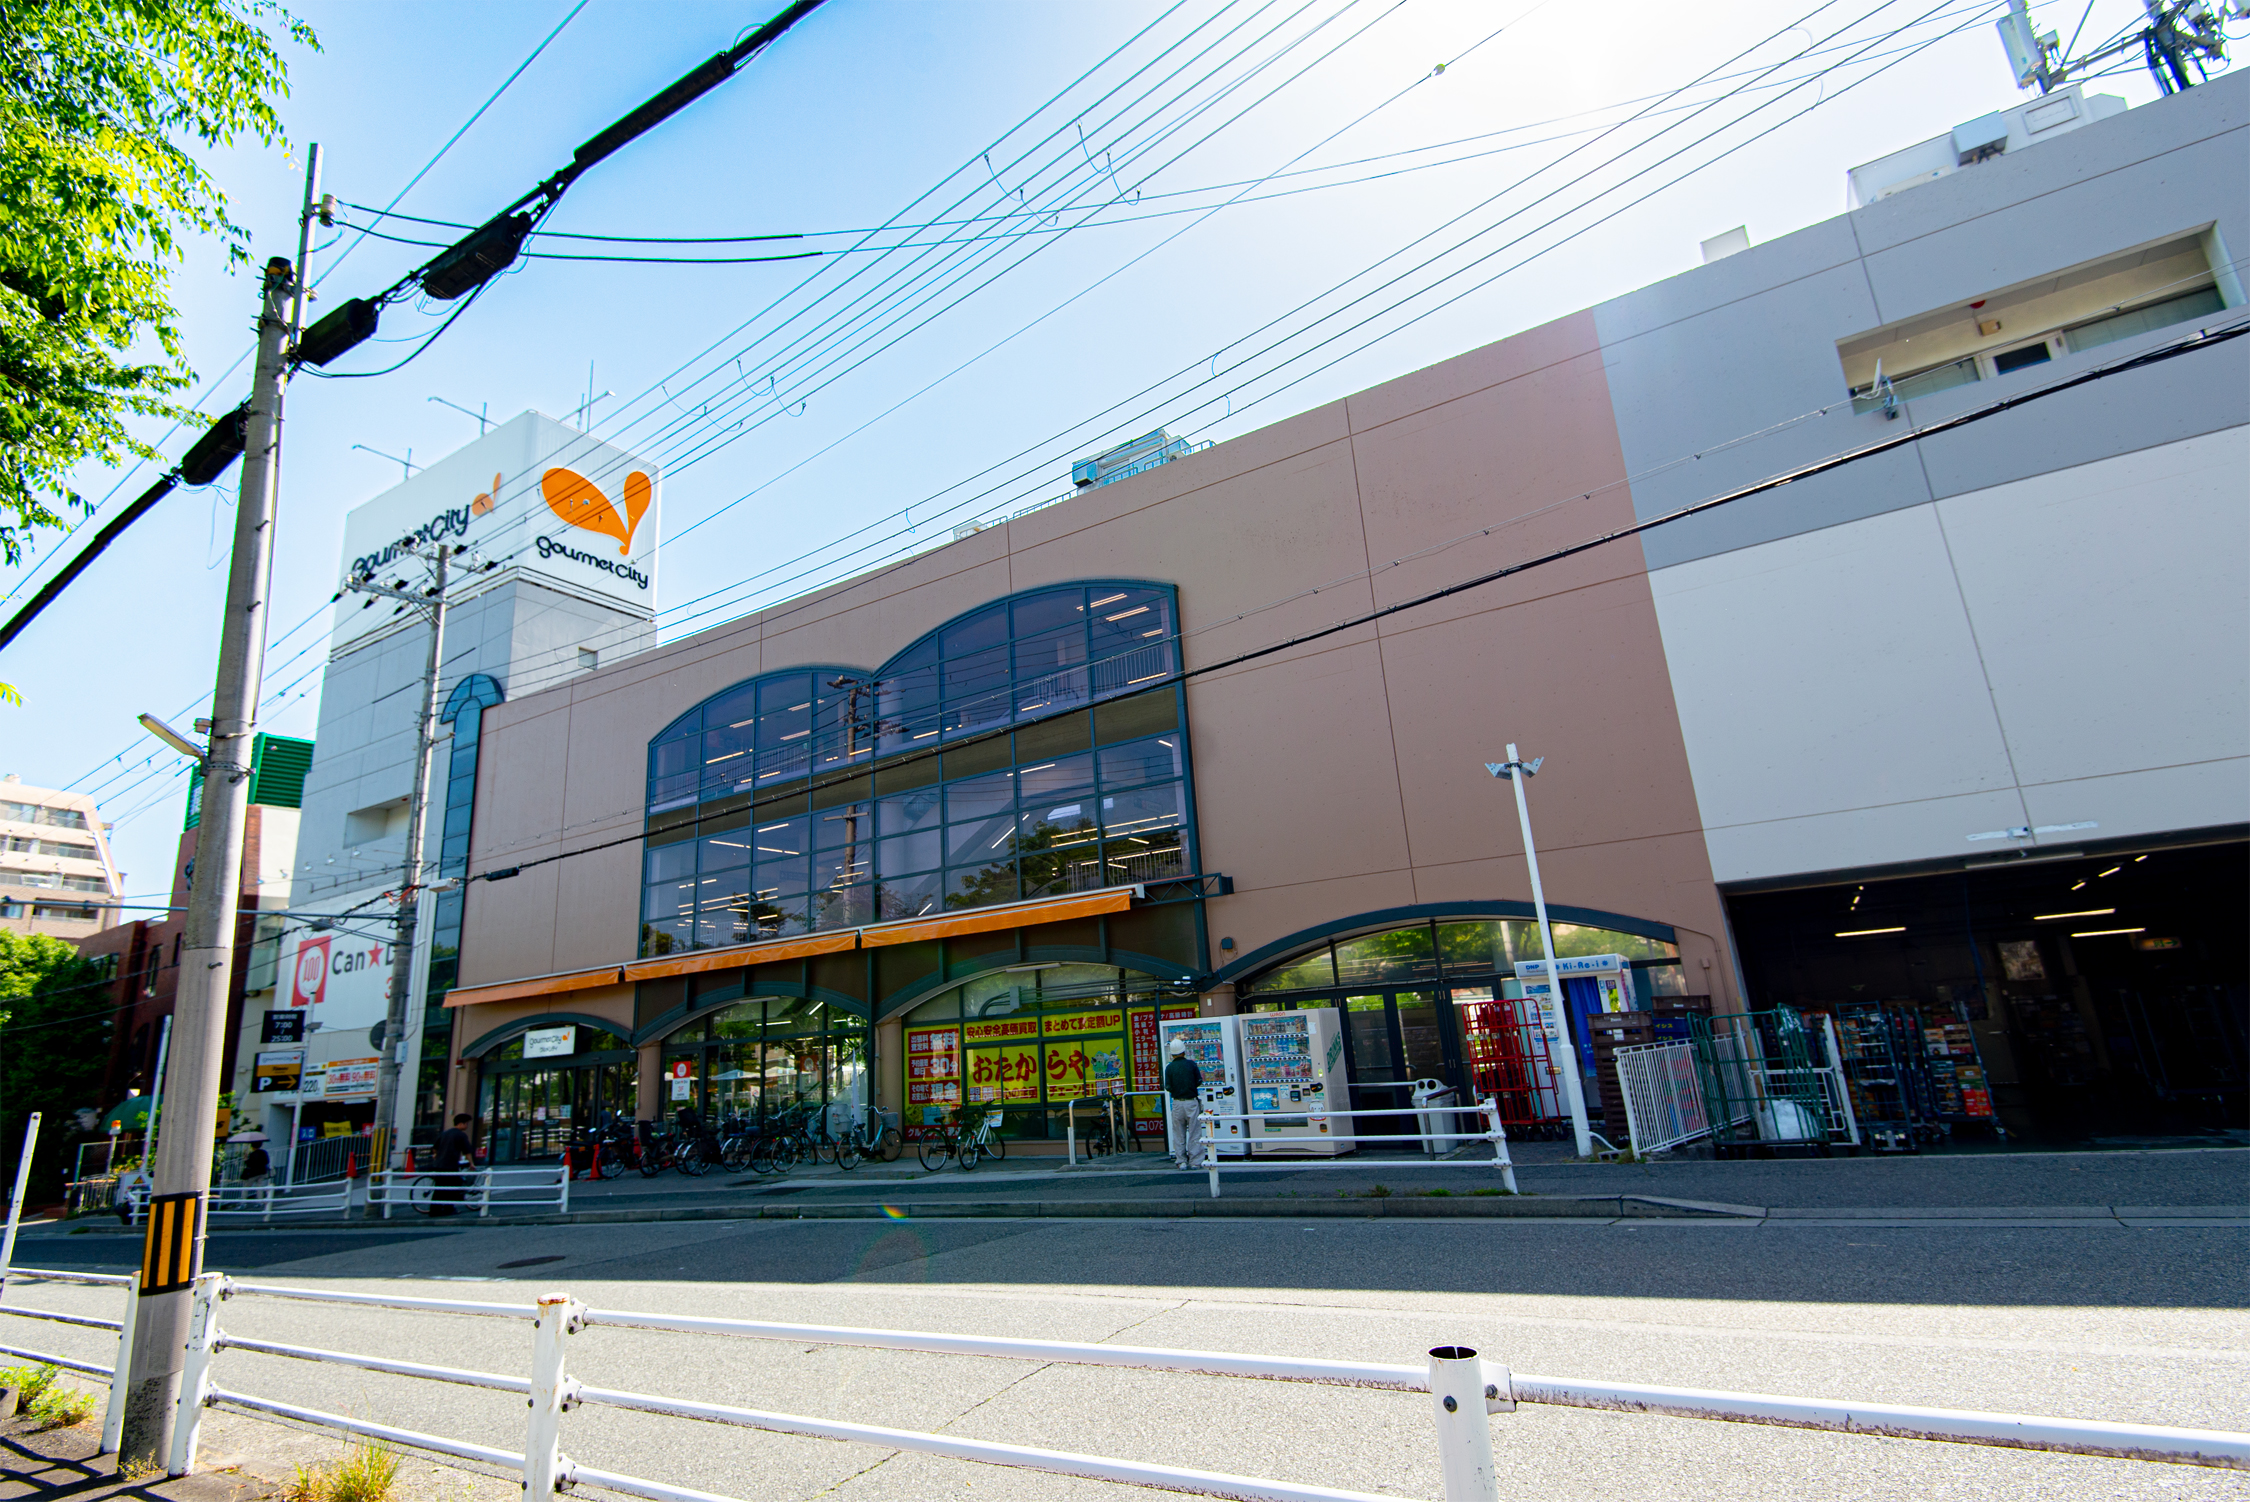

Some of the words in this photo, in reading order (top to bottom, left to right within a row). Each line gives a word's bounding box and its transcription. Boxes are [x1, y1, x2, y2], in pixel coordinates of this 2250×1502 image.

[930, 1032, 956, 1050] 無料
[258, 1077, 273, 1092] P
[930, 1082, 958, 1100] 現金
